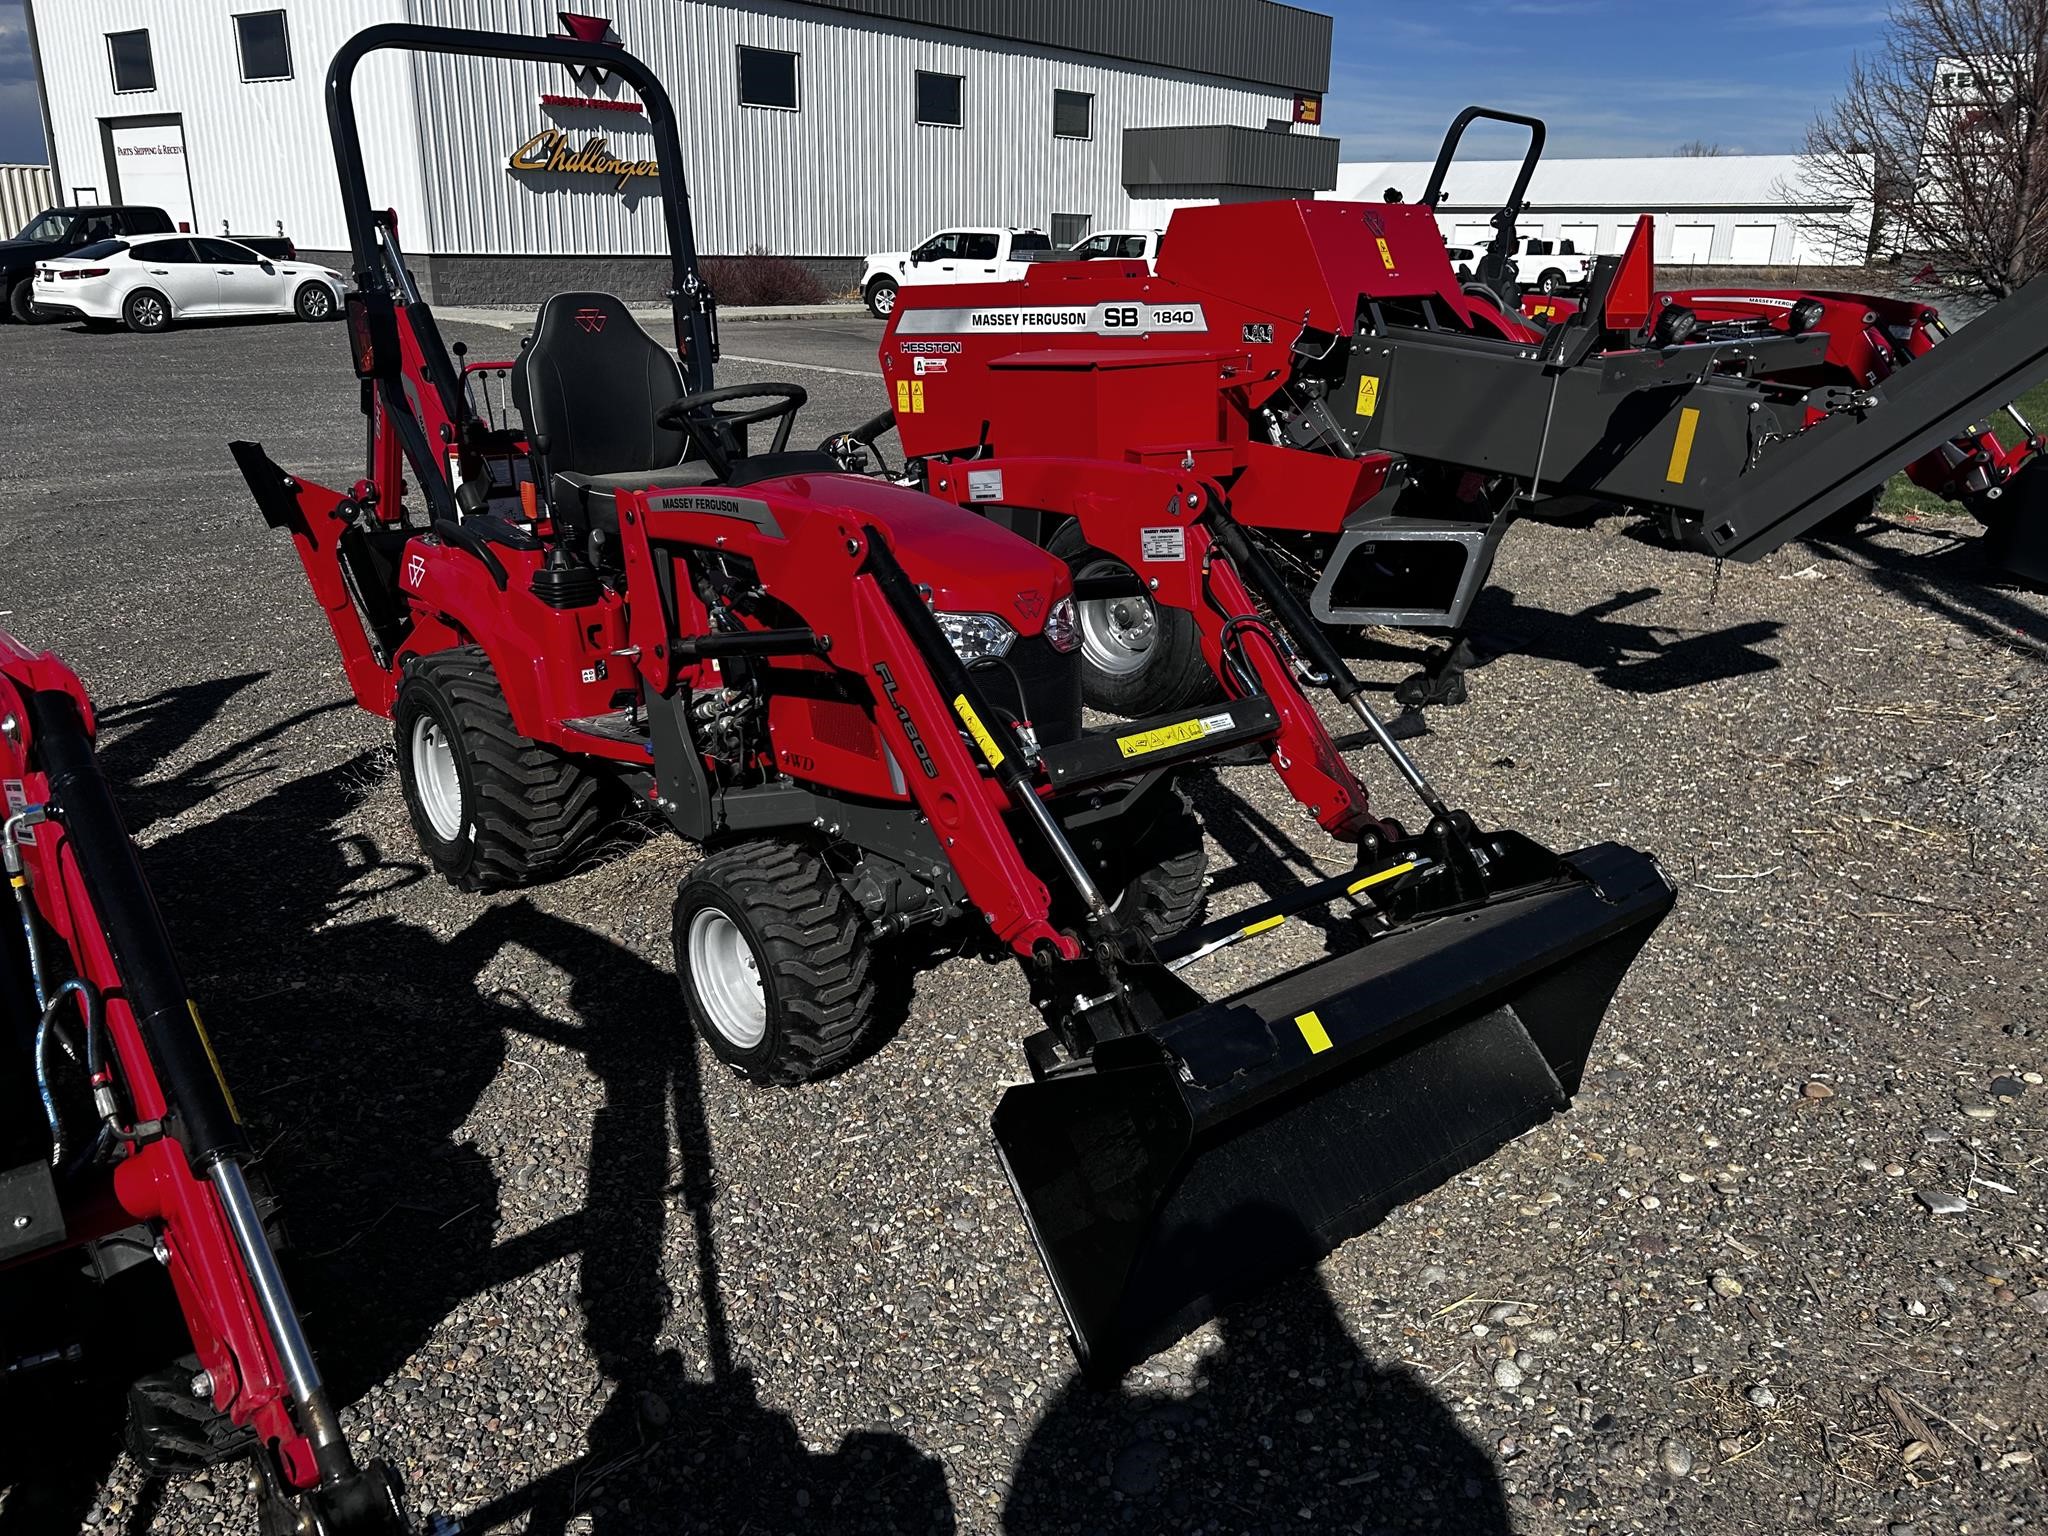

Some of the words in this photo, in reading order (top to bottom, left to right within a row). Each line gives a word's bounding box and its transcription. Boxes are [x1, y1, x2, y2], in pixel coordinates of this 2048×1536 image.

[510, 130, 660, 190] Challenger
[972, 313, 1019, 326] MASSEY
[1022, 312, 1086, 325] FERGUSON
[1104, 308, 1139, 327] SB
[1153, 311, 1194, 324] 1840
[901, 342, 961, 353] HESSTON
[662, 498, 694, 509] MASSEY
[695, 499, 739, 513] FERGUSON
